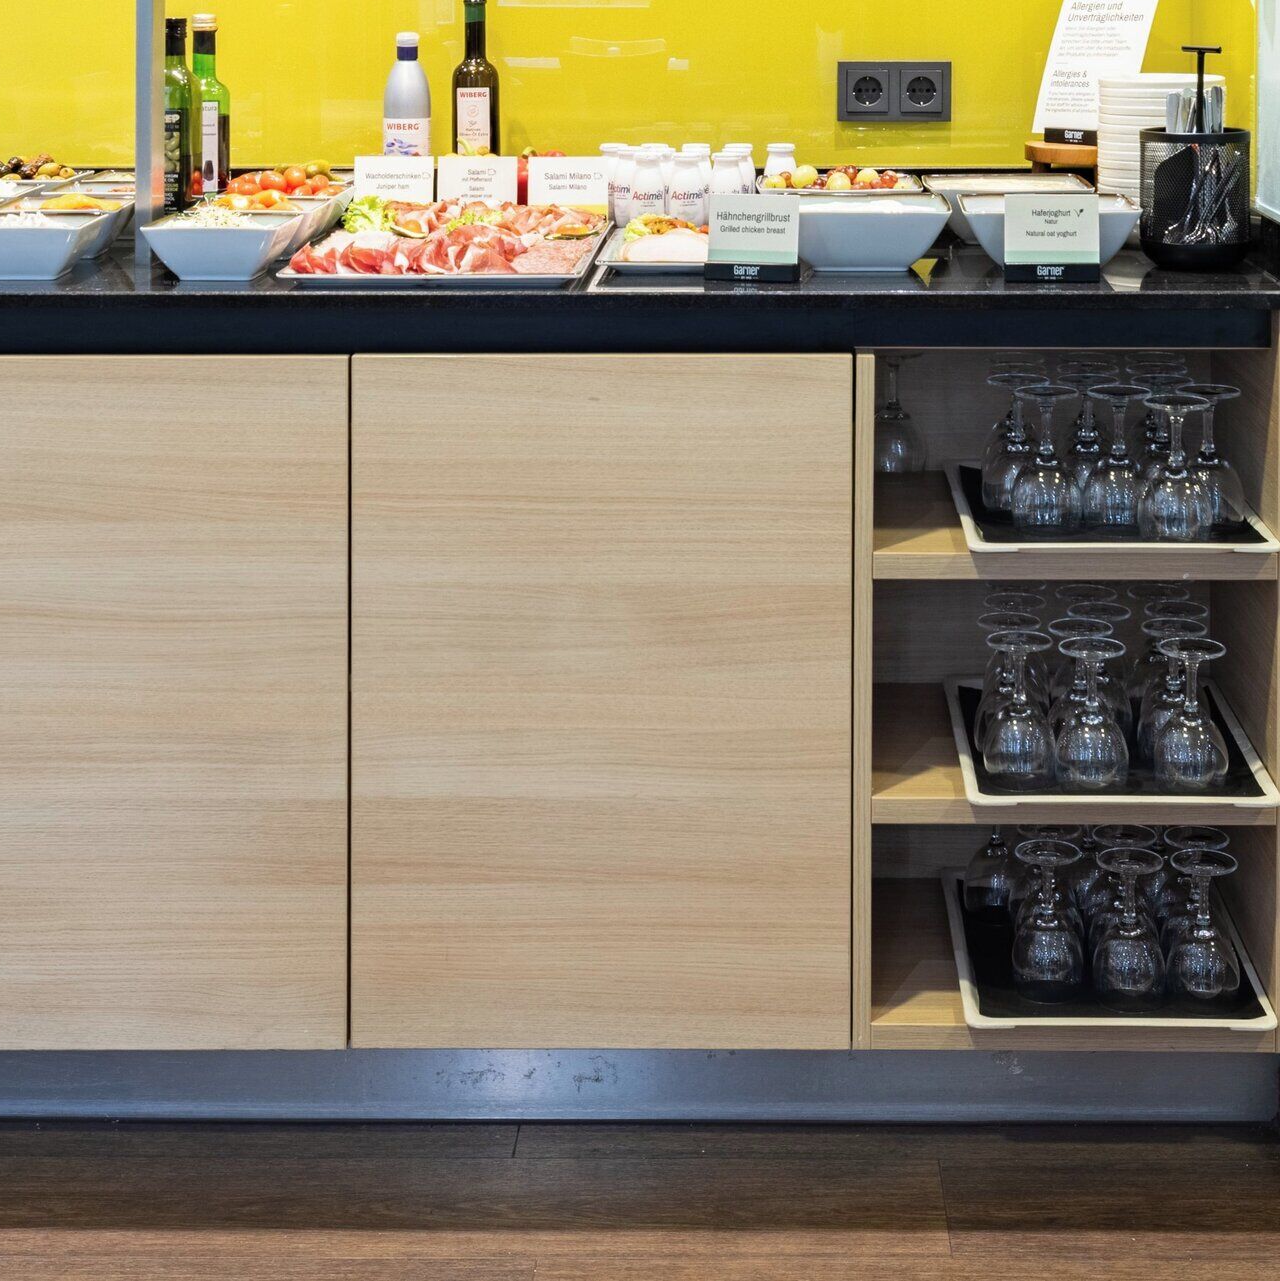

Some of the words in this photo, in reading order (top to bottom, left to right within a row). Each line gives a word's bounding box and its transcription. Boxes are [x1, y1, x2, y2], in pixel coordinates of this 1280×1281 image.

[1071, 2, 1105, 12] Allergien
[1107, 1, 1123, 10] und
[1053, 70, 1081, 79] Allergies
[1065, 130, 1084, 139] Garner
[717, 211, 790, 223] Hähnchengrillbrust
[1032, 209, 1071, 218] Haferjoghurt
[766, 226, 786, 234] breast
[734, 265, 760, 275] Garner
[1037, 266, 1064, 276] Garner
